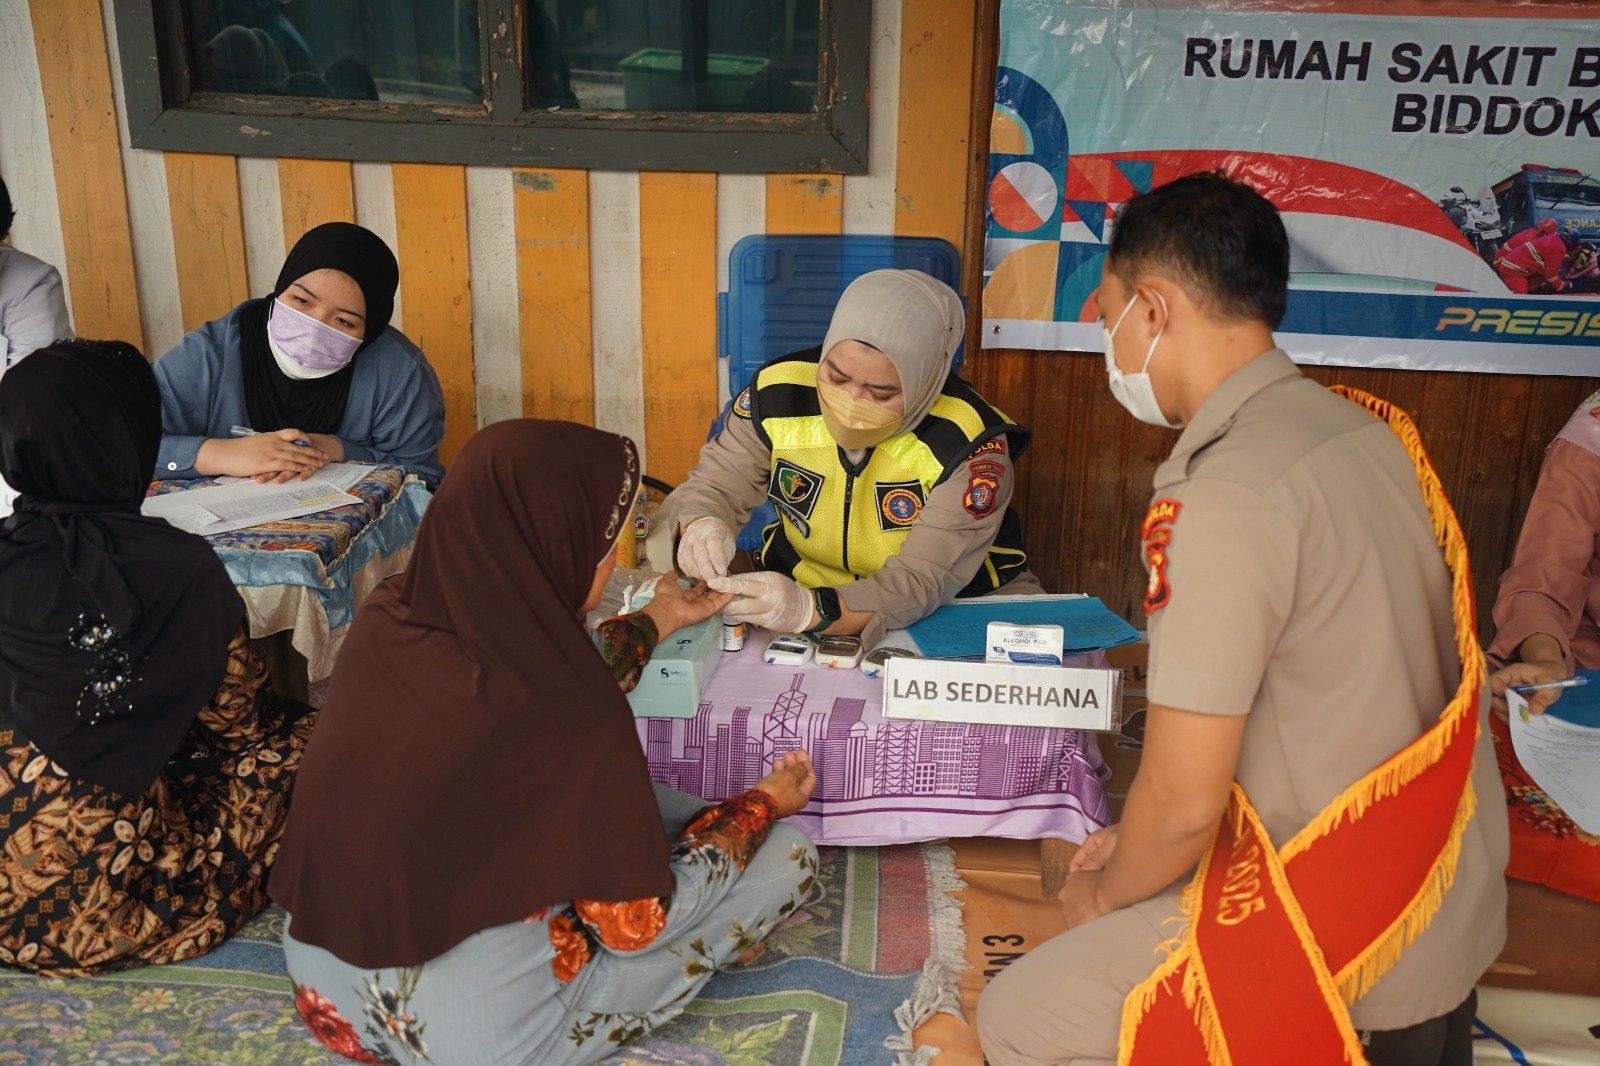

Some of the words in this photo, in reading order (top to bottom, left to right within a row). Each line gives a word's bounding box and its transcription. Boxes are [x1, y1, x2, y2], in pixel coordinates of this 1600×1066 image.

[1184, 38, 1372, 81] RUMAH
[1387, 42, 1557, 87] SAKIT
[1568, 47, 1600, 88] B
[1391, 92, 1600, 138] BIDDOK
[968, 441, 1002, 459] LDA
[1003, 637, 1031, 645] ALCOHOL
[893, 678, 938, 700] LAB
[946, 681, 1099, 709] SEDERHANA
[1216, 845, 1266, 925] 2025
